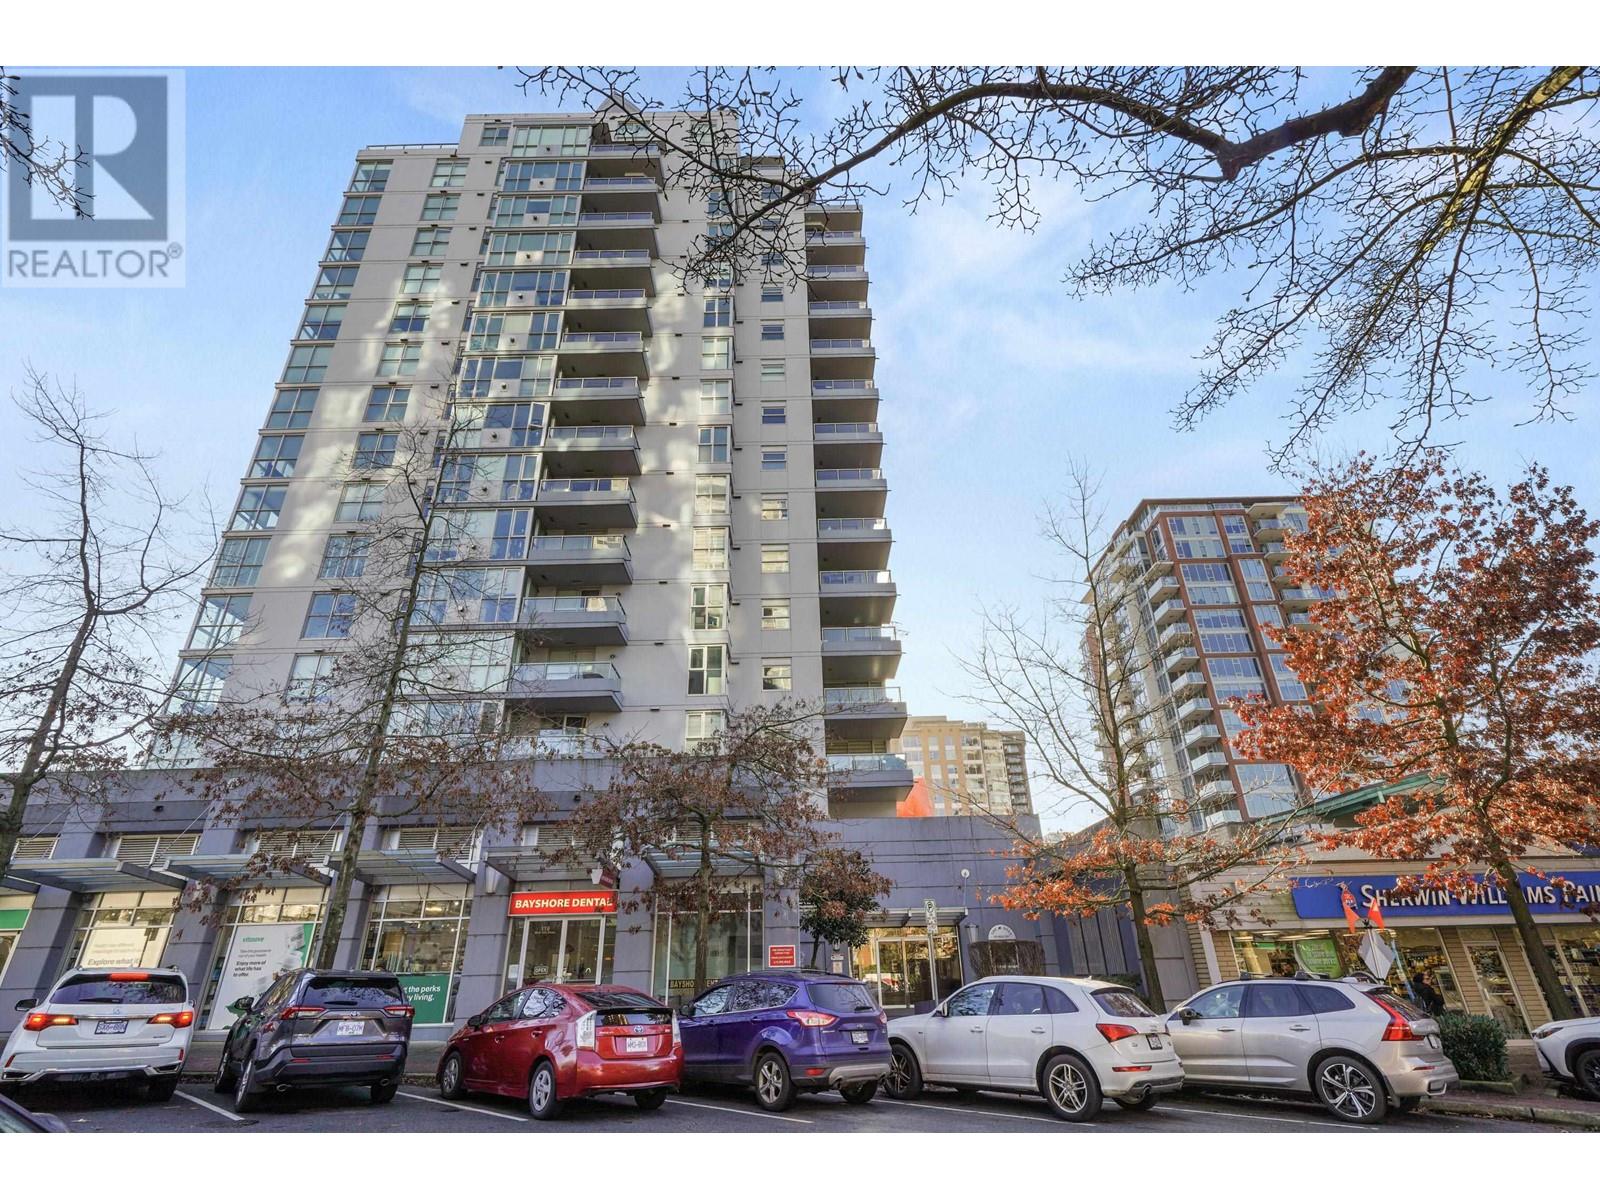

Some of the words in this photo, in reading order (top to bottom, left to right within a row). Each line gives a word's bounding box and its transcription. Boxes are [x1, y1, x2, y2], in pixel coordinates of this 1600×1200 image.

[515, 899, 570, 908] BAYSHORE
[572, 897, 613, 907] DENTAL
[408, 985, 420, 993] the
[420, 985, 441, 993] perks
[413, 994, 435, 1002] living.
